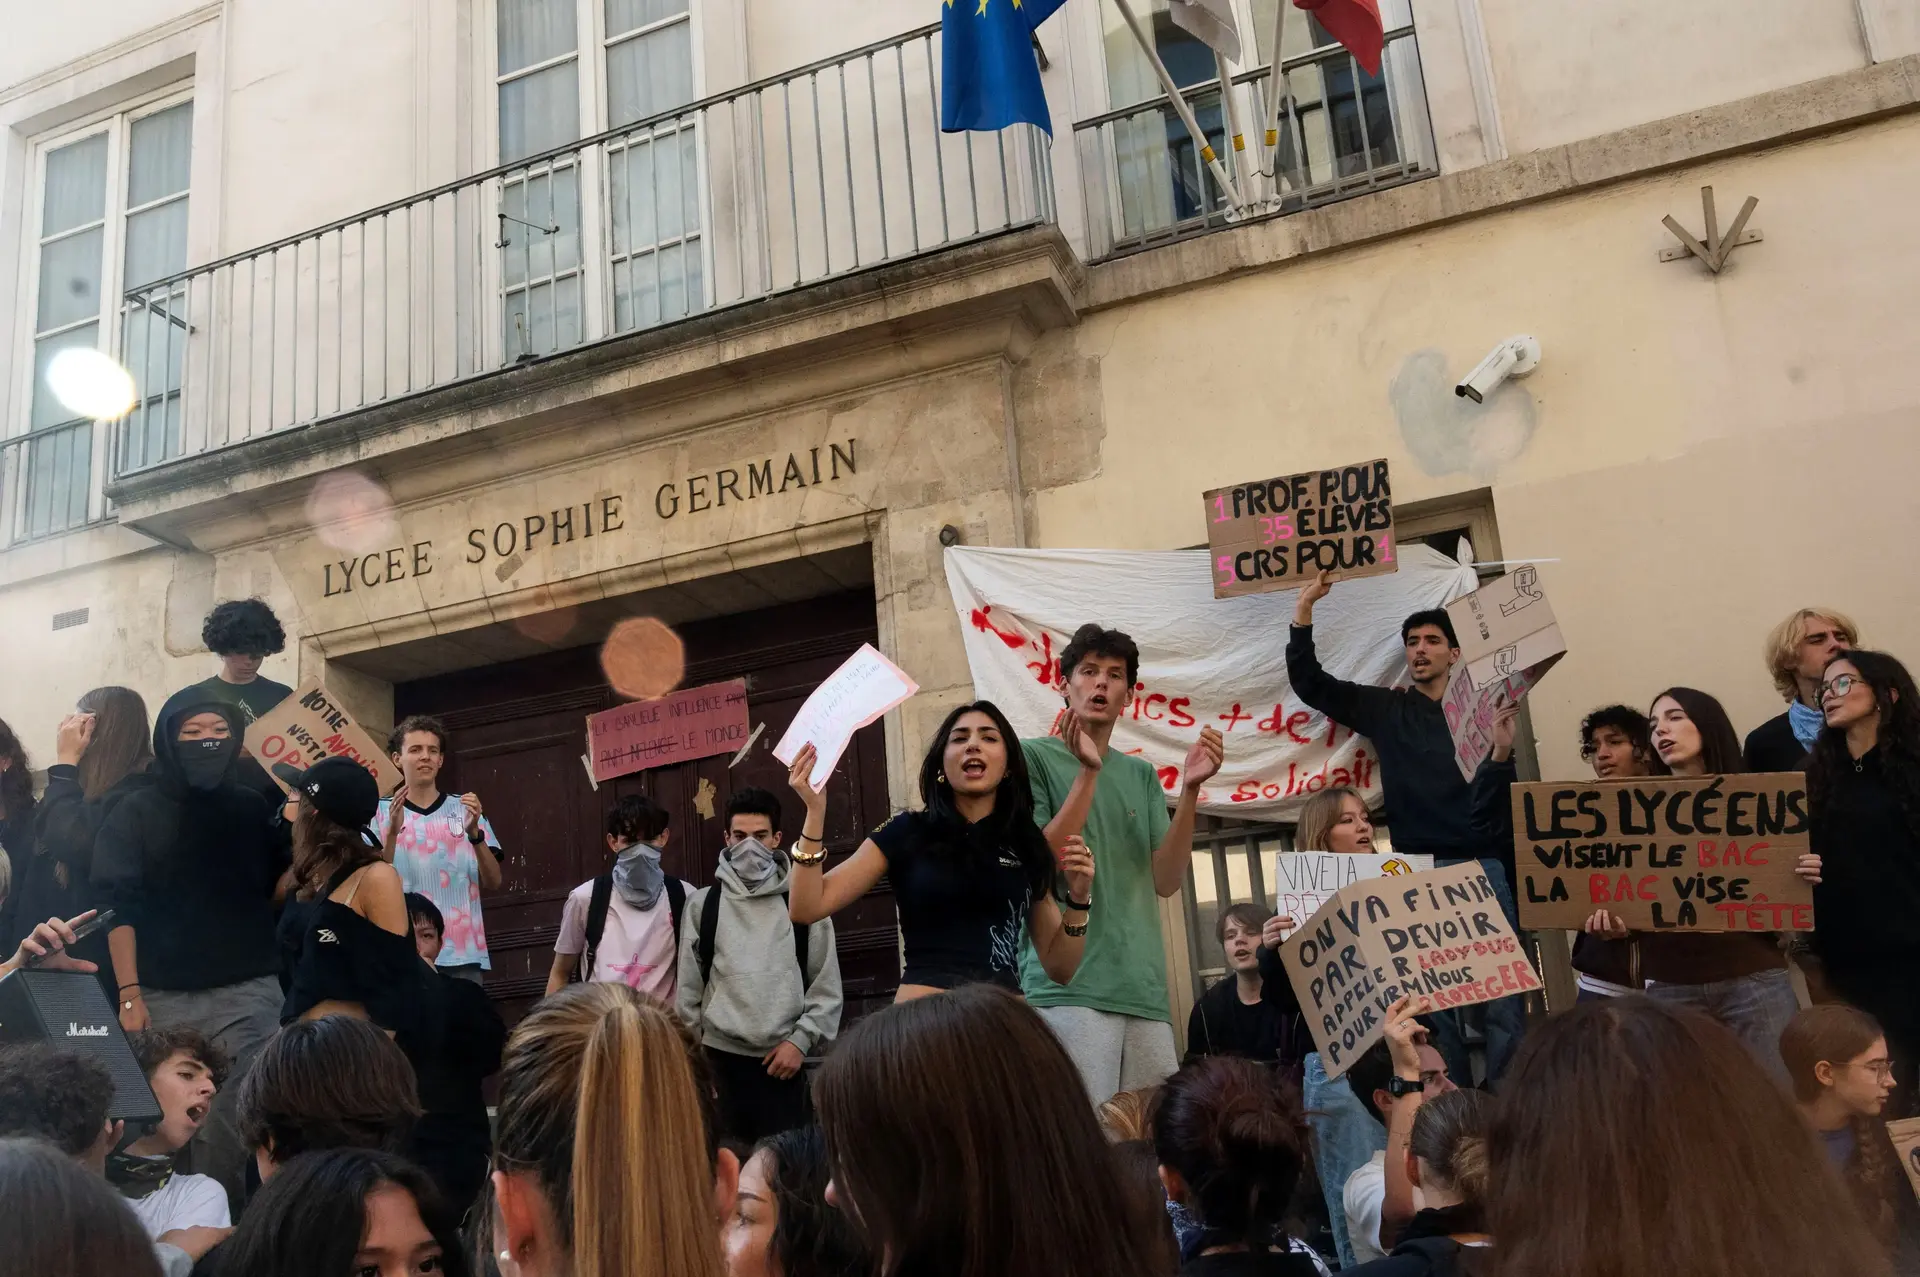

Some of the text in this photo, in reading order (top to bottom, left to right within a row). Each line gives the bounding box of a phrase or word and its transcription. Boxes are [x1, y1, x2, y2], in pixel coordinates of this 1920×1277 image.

[1212, 495, 1232, 524] 1
[1319, 460, 1391, 507] POUR
[323, 438, 859, 598] LYCEE SOPHIE GERMAIN
[1258, 494, 1392, 545] 35 ÉLÈVES
[1216, 534, 1395, 587] 5 CRS POUR 1
[299, 687, 349, 733] NOTRE
[614, 705, 661, 731] BANLIEUE
[668, 696, 722, 718] INFLUENCE
[1257, 702, 1312, 745] de
[286, 723, 321, 754] N'EST
[682, 733, 698, 750] LE
[705, 722, 748, 746] MONDE
[1523, 777, 1810, 842] LES LYCÉENS
[1648, 843, 1687, 868] LE
[1697, 840, 1771, 868] BAC
[1525, 875, 1569, 903] LA
[1588, 872, 1661, 904] BAC
[1299, 916, 1337, 968] ON
[1335, 894, 1391, 937] VA
[1651, 892, 1815, 930] LA TÊTE
[1417, 936, 1518, 971] LADYBUG
[1310, 944, 1367, 1012] PAR
[66, 1022, 109, 1037] Marshall
[1327, 1005, 1379, 1067] POUR
